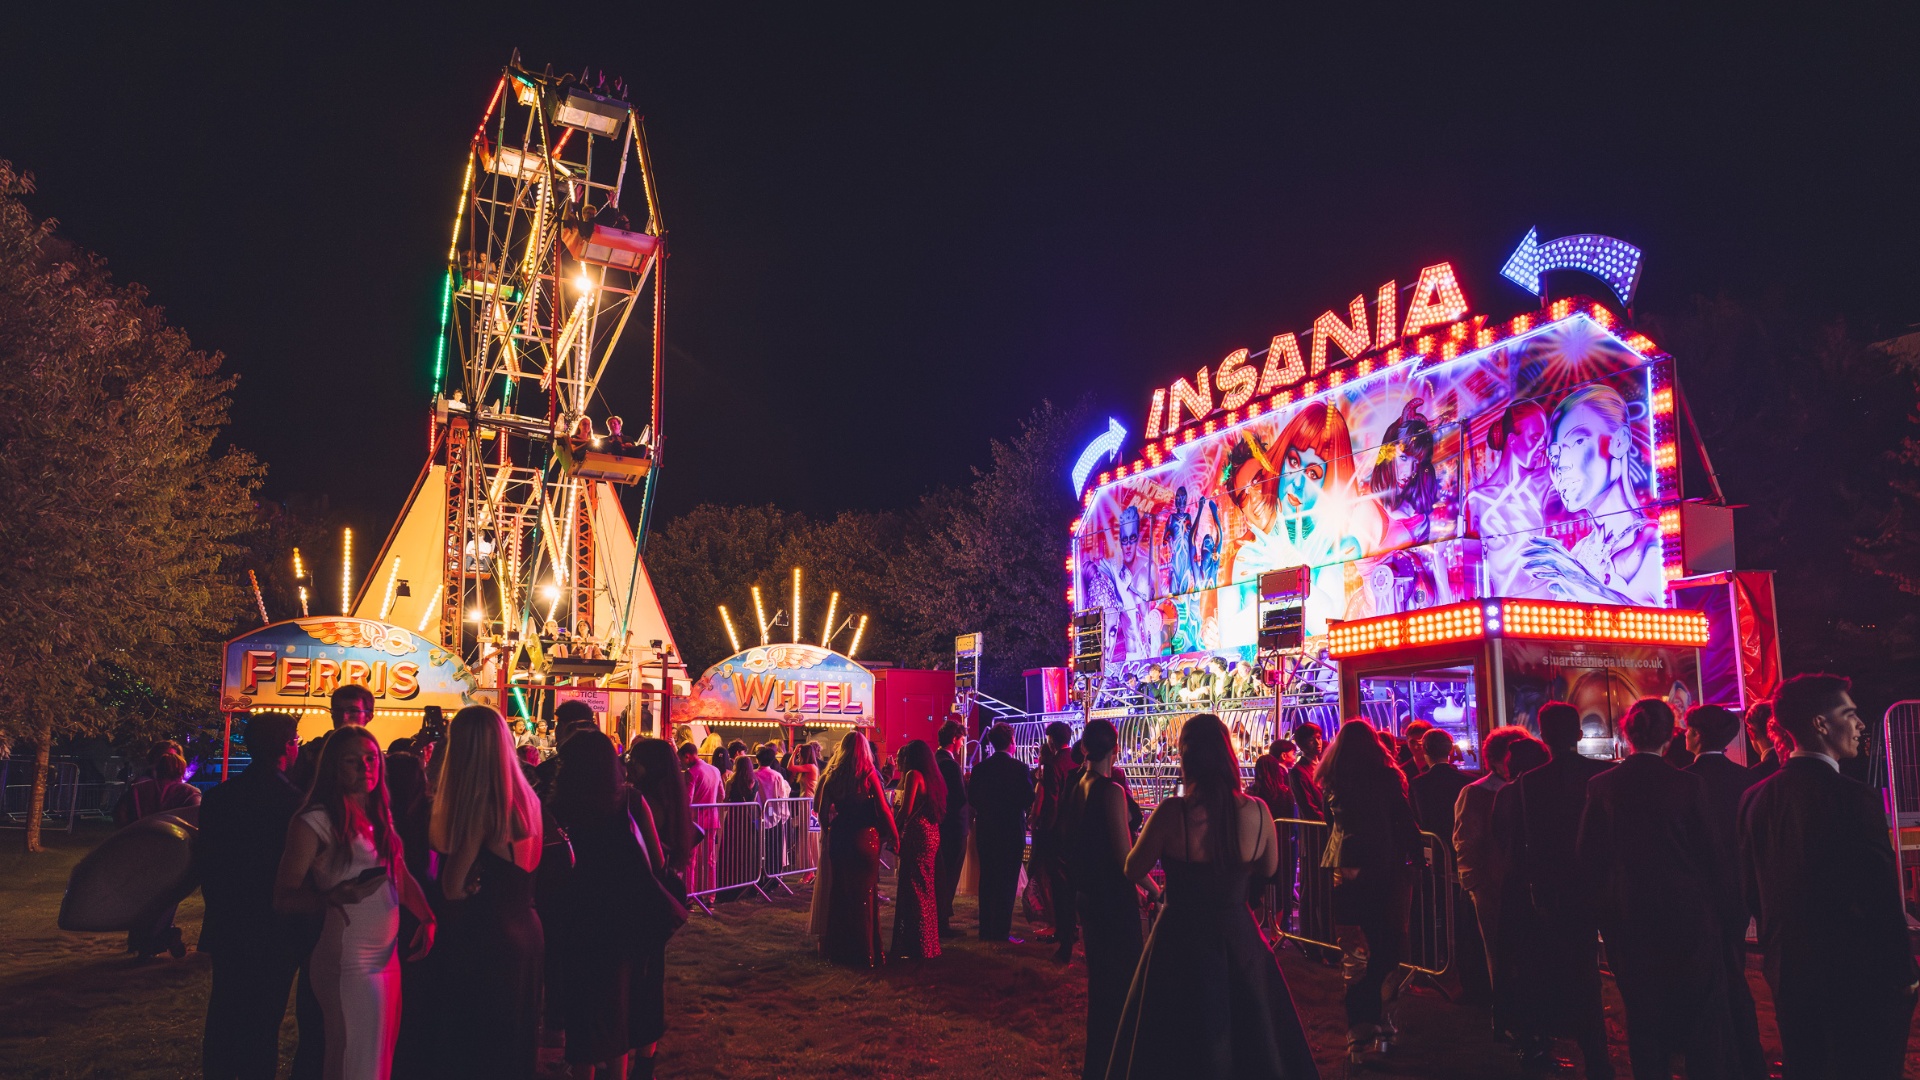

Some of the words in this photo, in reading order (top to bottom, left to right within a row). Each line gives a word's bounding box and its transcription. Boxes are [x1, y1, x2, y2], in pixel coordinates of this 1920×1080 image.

[1145, 262, 1467, 439] INSANIA
[240, 650, 420, 700] FERRIS
[731, 672, 863, 714] WHEEL
